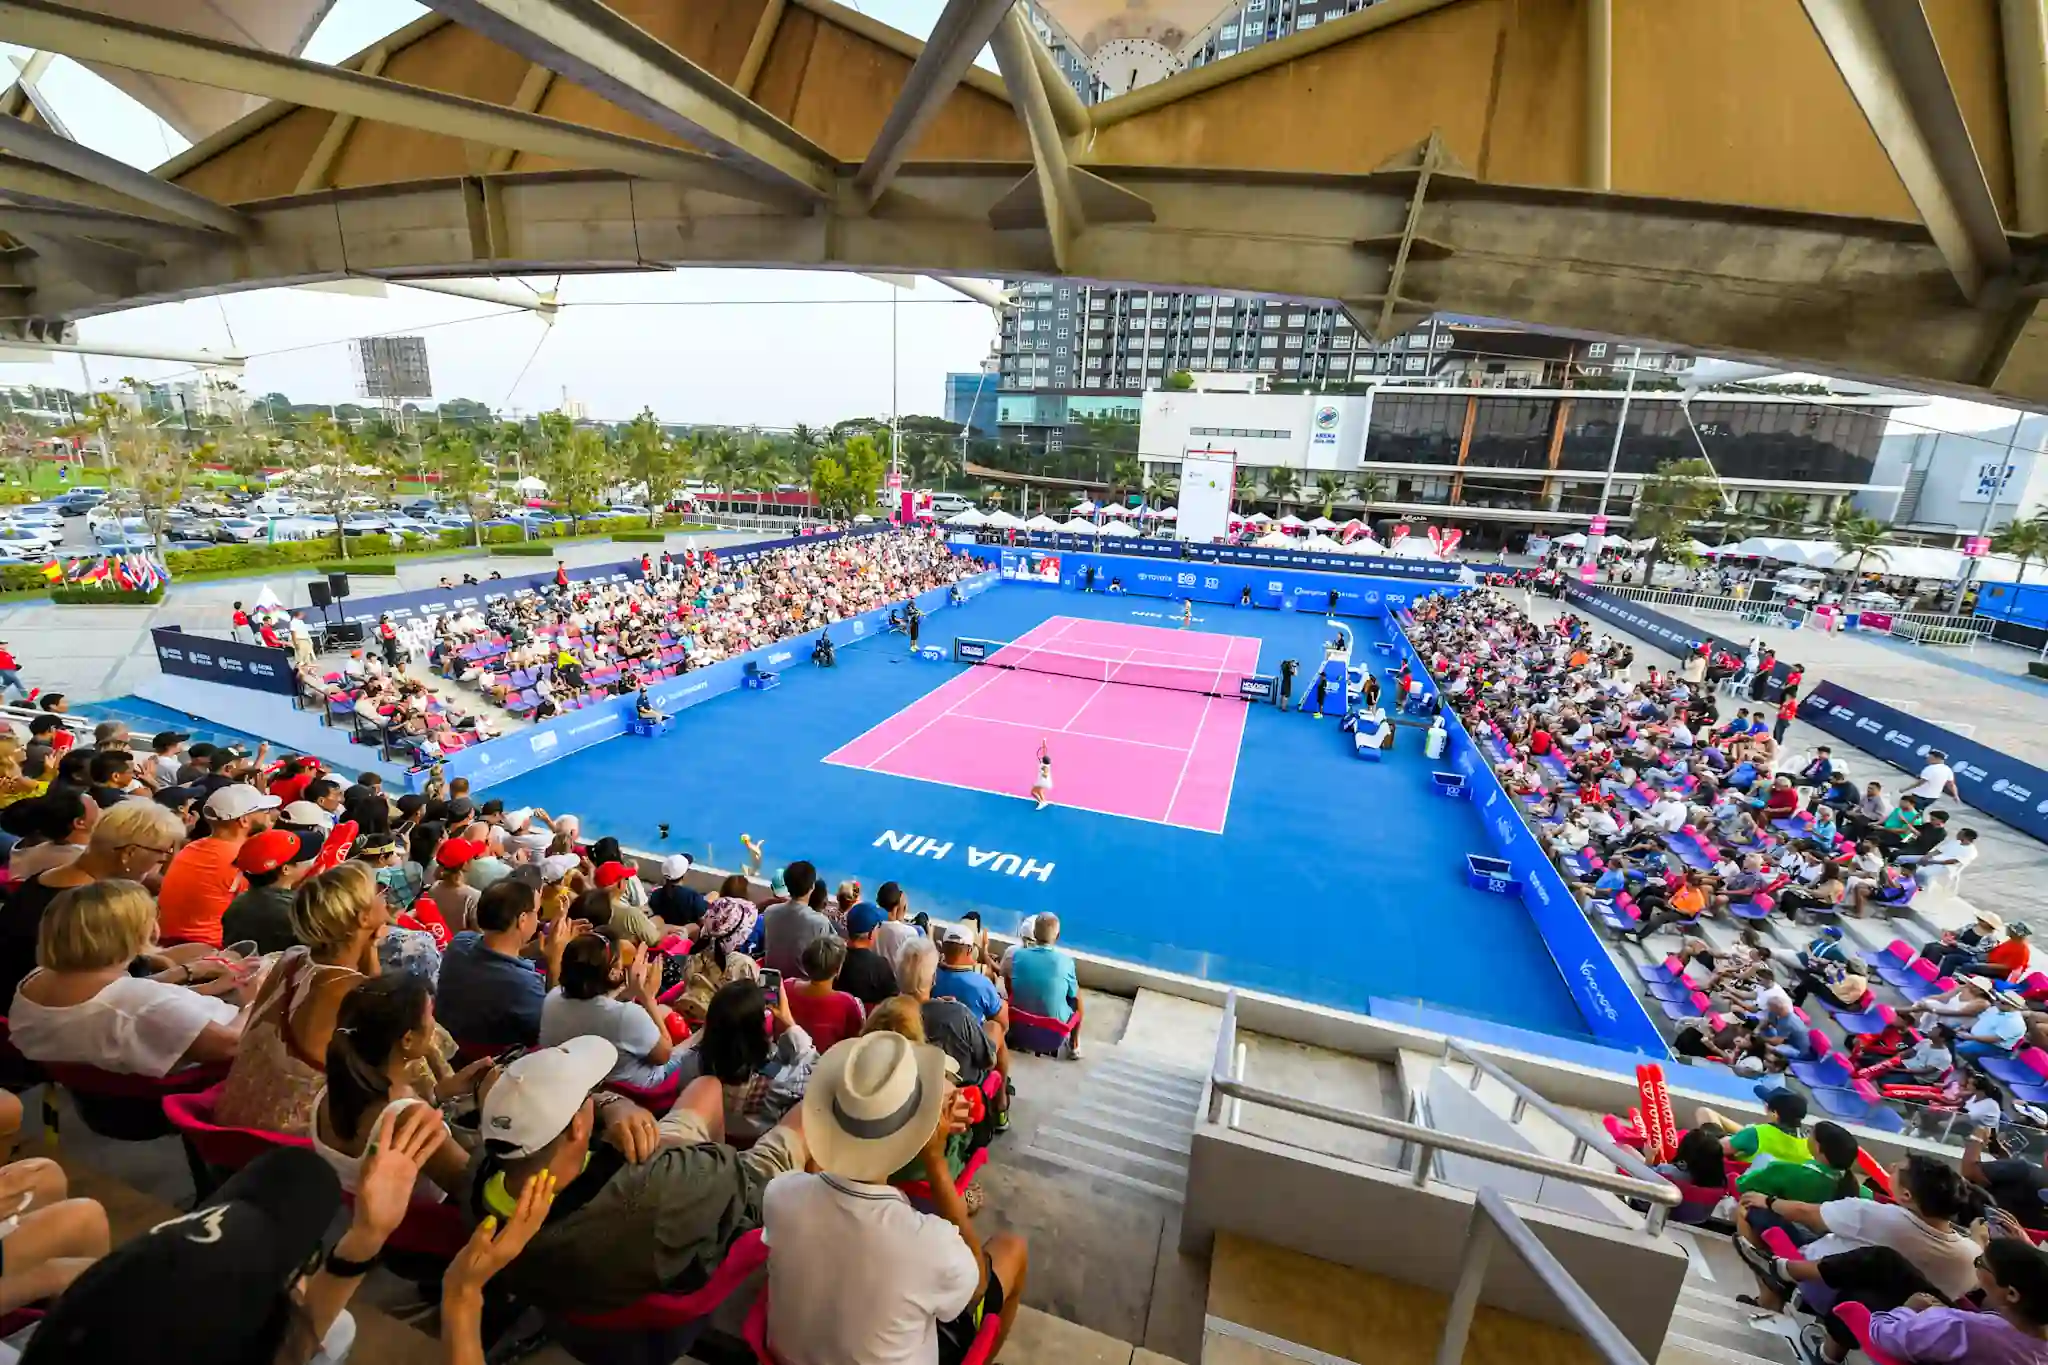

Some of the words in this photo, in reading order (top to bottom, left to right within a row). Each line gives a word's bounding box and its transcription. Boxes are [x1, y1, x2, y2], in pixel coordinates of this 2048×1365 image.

[872, 829, 954, 860] HIN
[968, 845, 1056, 882] HUA
[1656, 1080, 1675, 1124] TOYOTA
[1647, 1103, 1662, 1149] TOYOTA
